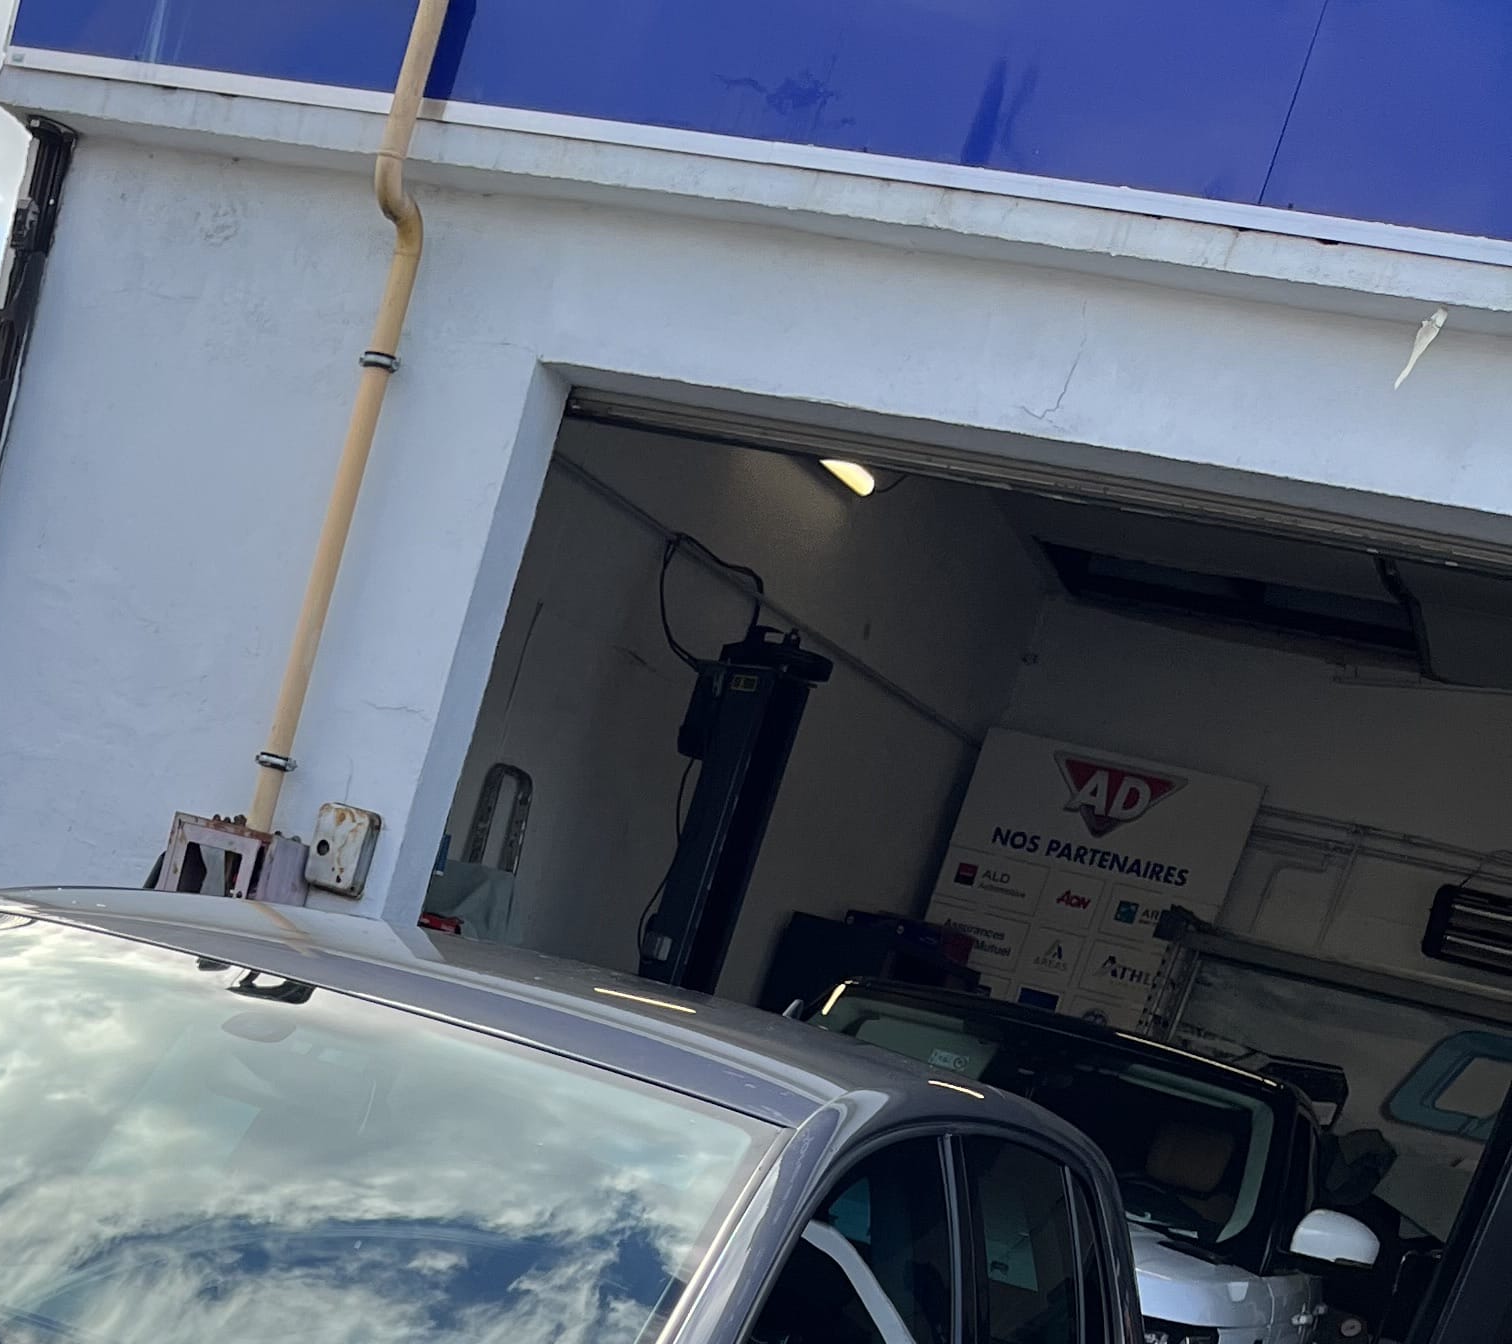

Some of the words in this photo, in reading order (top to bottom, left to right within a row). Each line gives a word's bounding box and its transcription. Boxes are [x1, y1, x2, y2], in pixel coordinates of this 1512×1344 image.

[1070, 769, 1153, 821] AD
[992, 827, 1040, 853] NOS
[1046, 839, 1189, 887] PARTENAIRES
[981, 869, 1010, 883] ALD
[943, 918, 1005, 941] Assurances
